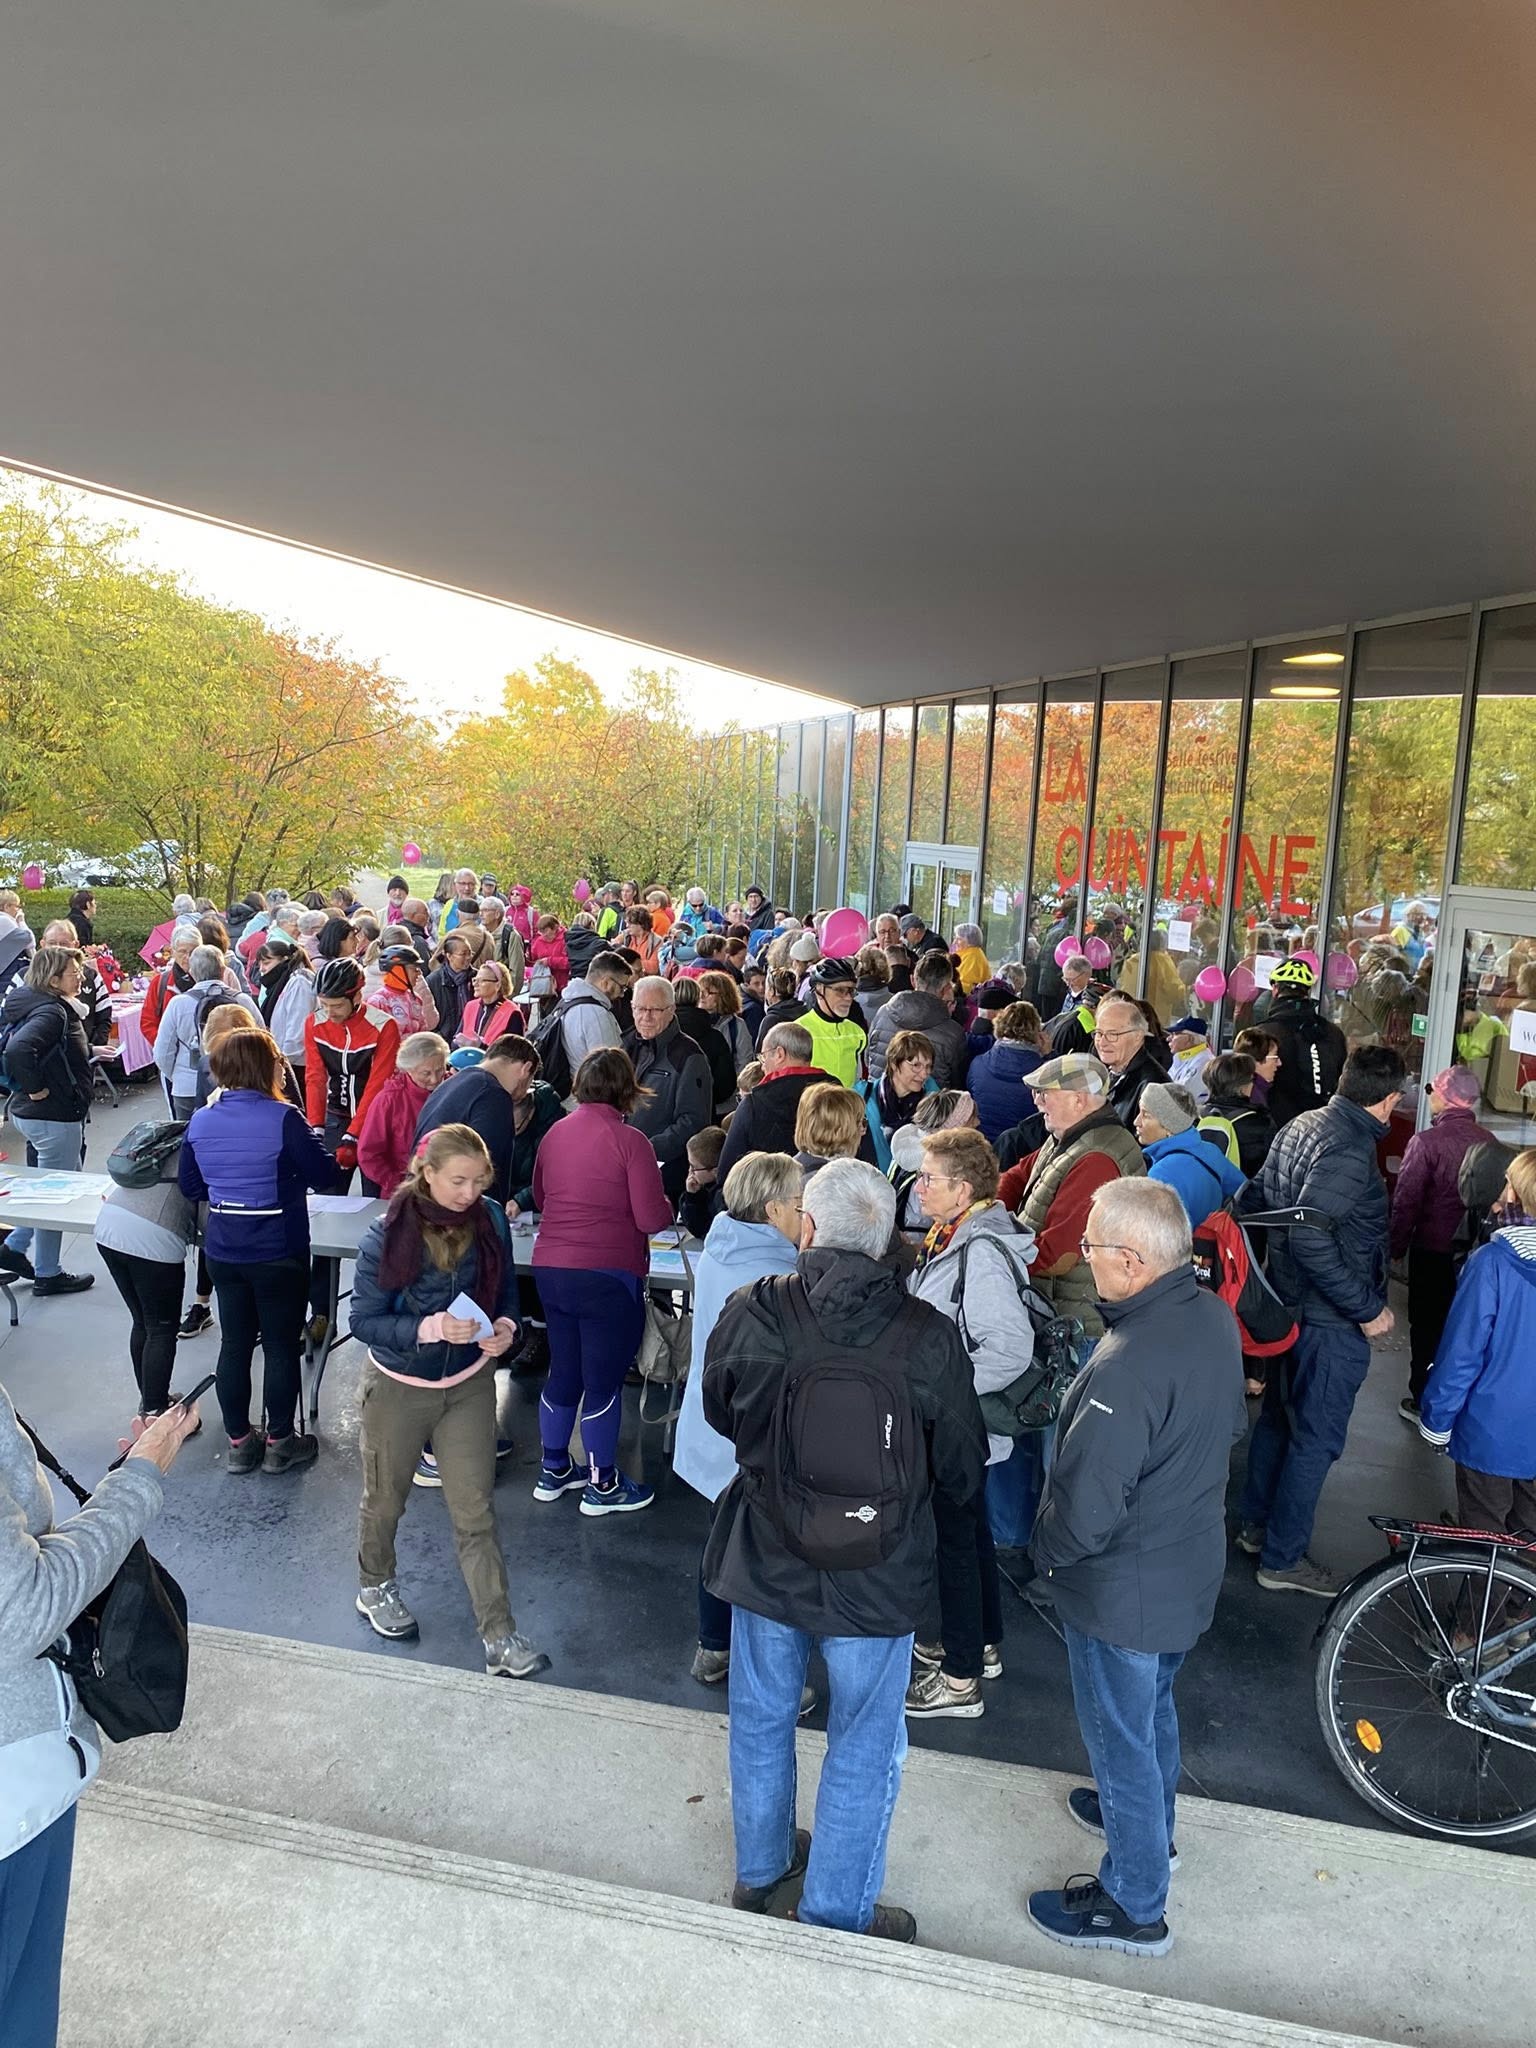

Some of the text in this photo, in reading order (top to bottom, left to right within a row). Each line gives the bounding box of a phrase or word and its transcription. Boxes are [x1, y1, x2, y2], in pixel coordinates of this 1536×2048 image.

[1045, 743, 1087, 802] LA
[1167, 748, 1238, 768] Salle festive
